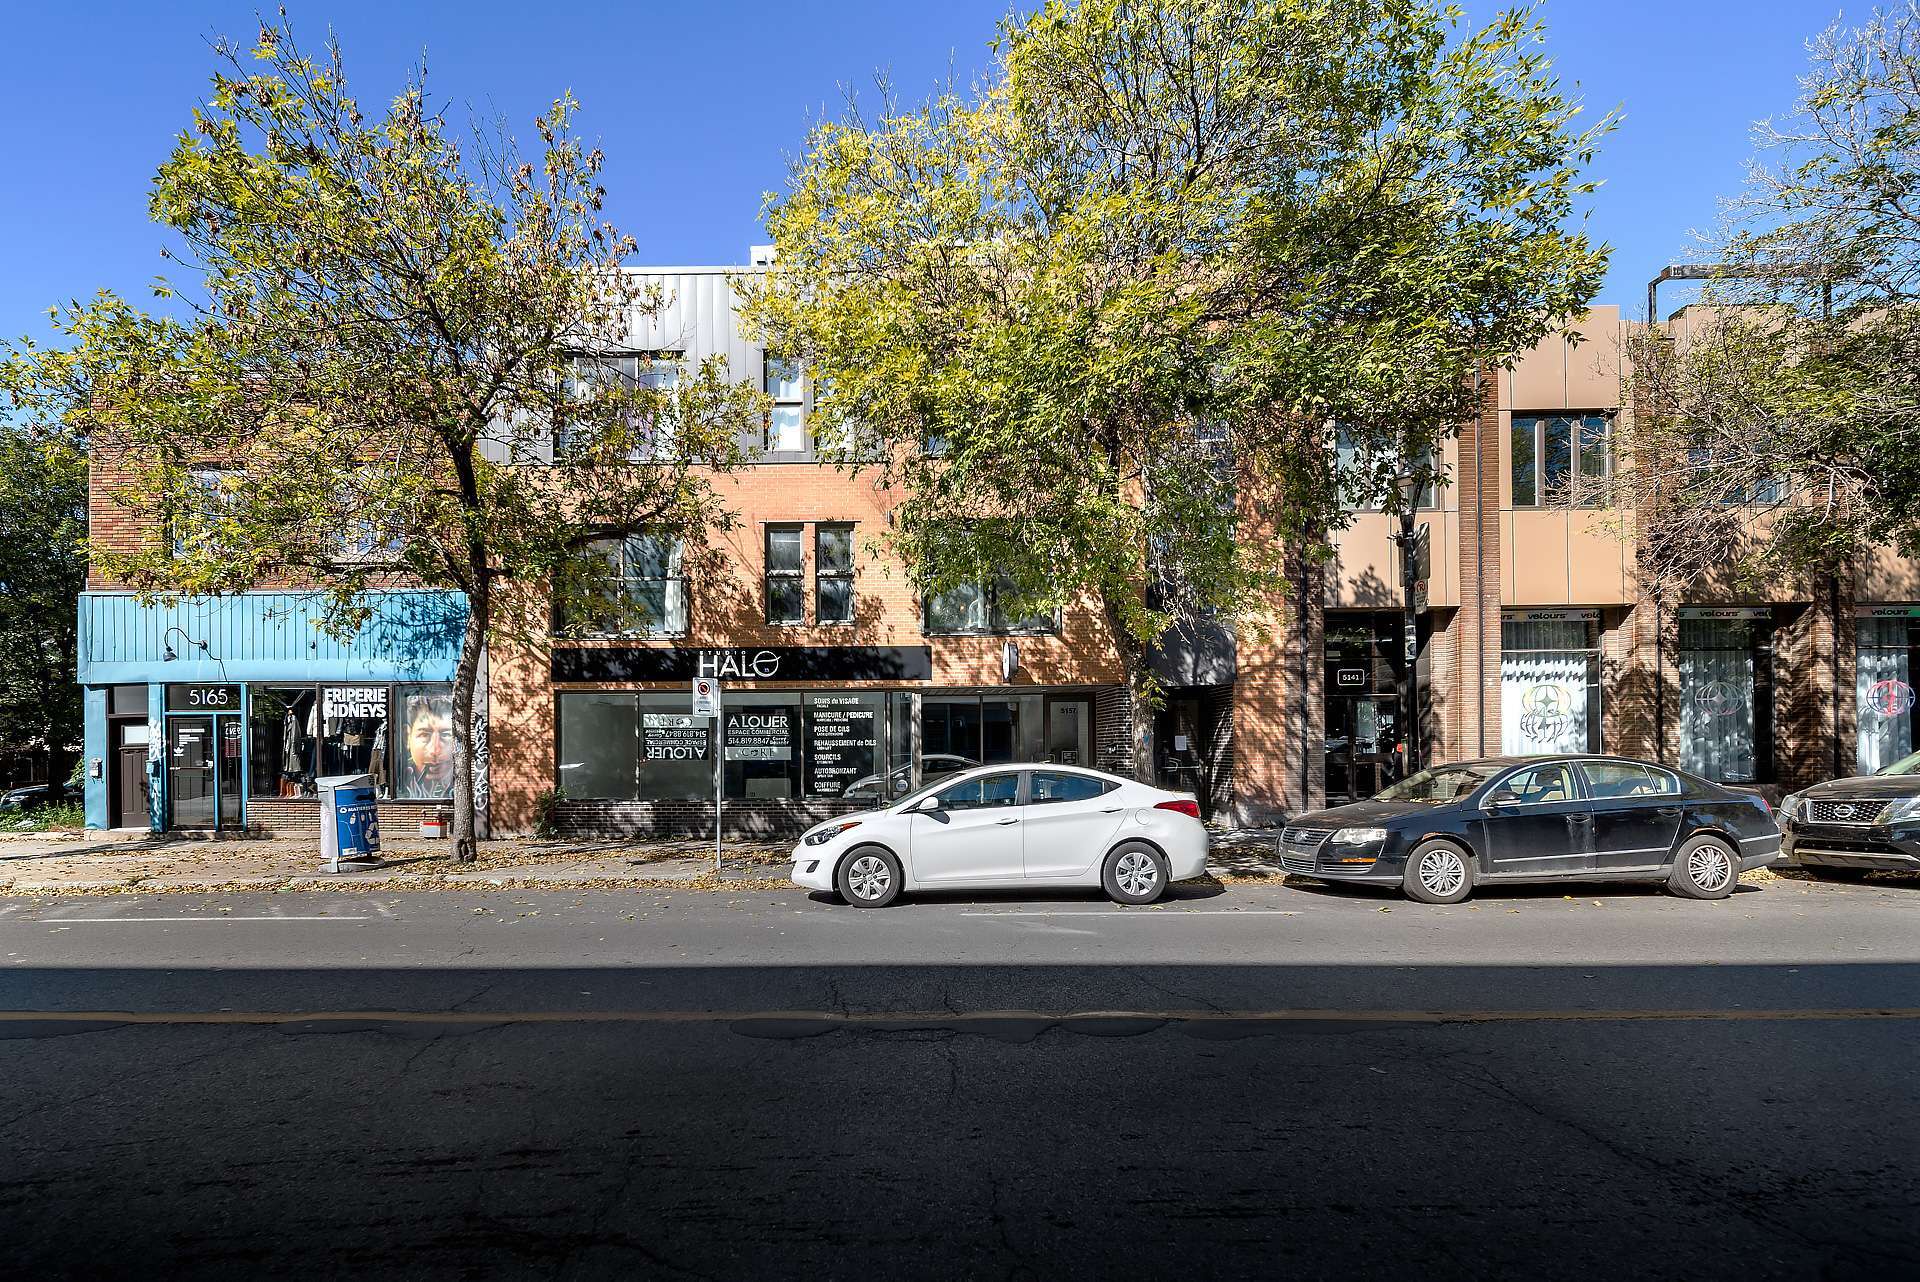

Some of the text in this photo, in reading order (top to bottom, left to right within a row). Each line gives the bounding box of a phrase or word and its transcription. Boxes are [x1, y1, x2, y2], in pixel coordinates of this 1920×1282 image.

[1528, 612, 1567, 620] velours
[1872, 608, 1911, 616] velours
[699, 650, 781, 678] HALO
[189, 688, 228, 705] 5165
[324, 688, 387, 703] FRIPERIE
[323, 703, 387, 718] SIDNEYS
[741, 715, 789, 728] LOUER
[646, 747, 692, 759] LOUER
